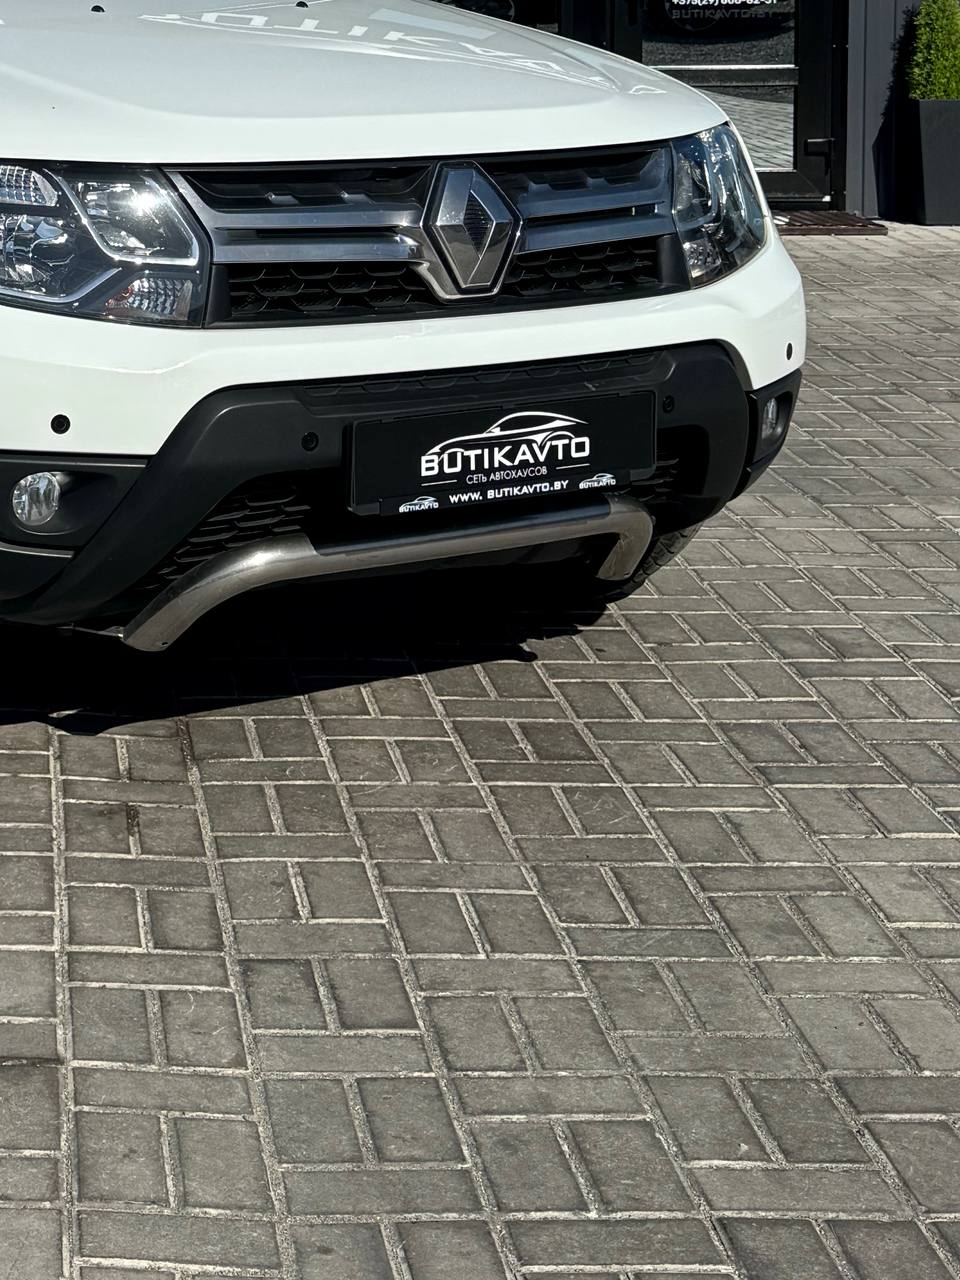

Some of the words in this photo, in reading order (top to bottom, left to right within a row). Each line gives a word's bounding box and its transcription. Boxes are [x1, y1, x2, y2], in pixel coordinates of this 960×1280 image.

[420, 436, 590, 477] BUTIKAVTO
[466, 473, 488, 485] СЕТЬ
[489, 466, 548, 483] АВТОХАУСОВ
[579, 478, 617, 490] BUTIKAVTO
[449, 492, 483, 504] WWW.
[487, 480, 569, 500] BUTIKAVTO.BY
[399, 501, 439, 513] BUTIKAVTO
